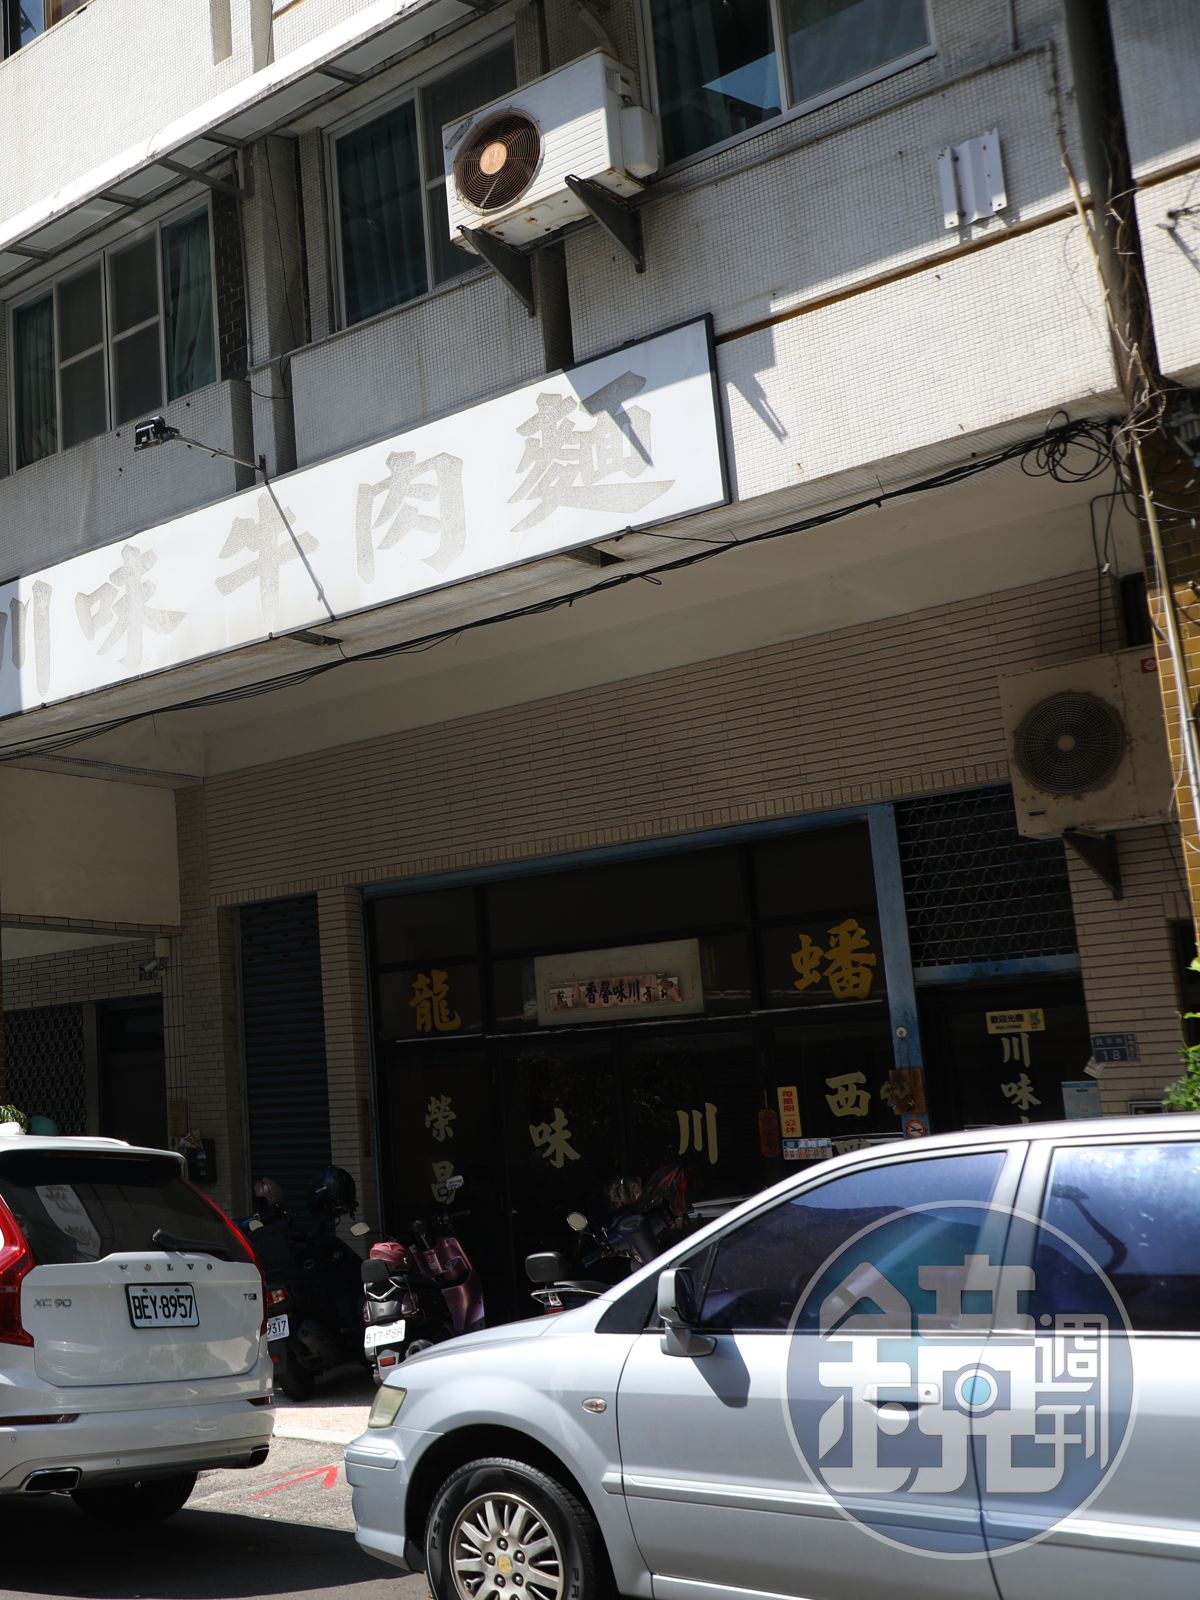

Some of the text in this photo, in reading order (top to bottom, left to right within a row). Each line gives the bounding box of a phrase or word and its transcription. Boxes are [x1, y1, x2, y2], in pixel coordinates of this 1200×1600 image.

[408, 918, 877, 1032] 蟠 龍
[1000, 1033, 1042, 1123] 川味
[1103, 1049, 1121, 1061] 18
[118, 1263, 213, 1272] VOLVO
